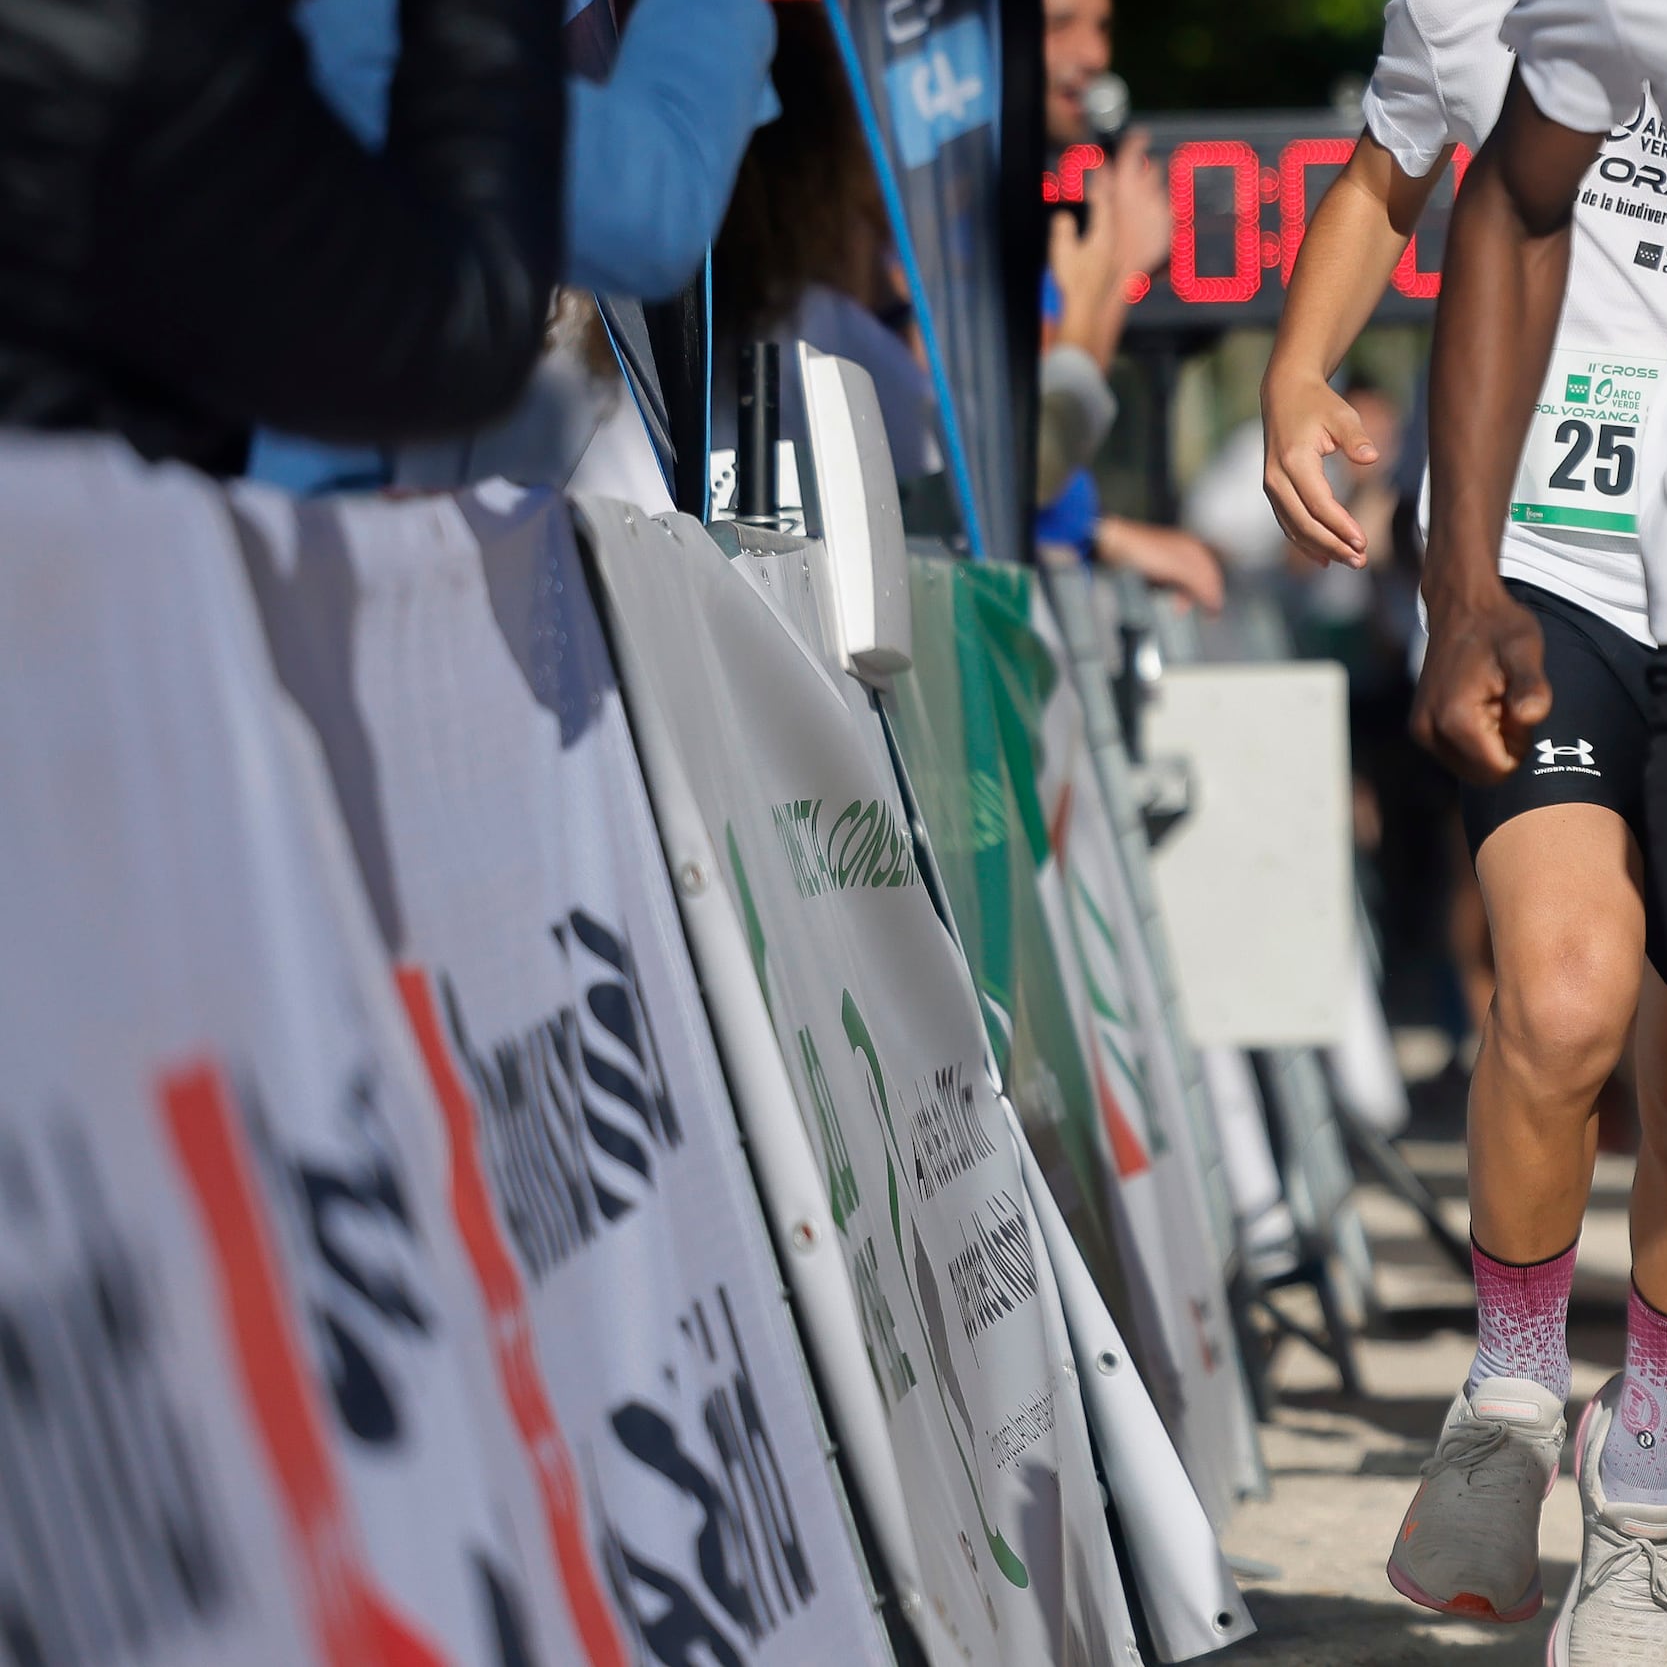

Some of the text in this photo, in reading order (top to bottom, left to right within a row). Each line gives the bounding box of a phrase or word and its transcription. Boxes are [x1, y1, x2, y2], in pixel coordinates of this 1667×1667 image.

[1581, 187, 1597, 207] de
[1600, 192, 1613, 212] la
[1601, 364, 1659, 380] CROSS
[1613, 389, 1642, 401] ARCO
[1611, 399, 1641, 411] VERDE
[1532, 403, 1641, 425] POLVORANCA
[1548, 419, 1638, 497] 25
[1533, 765, 1602, 778] UNDER ARMOUR
